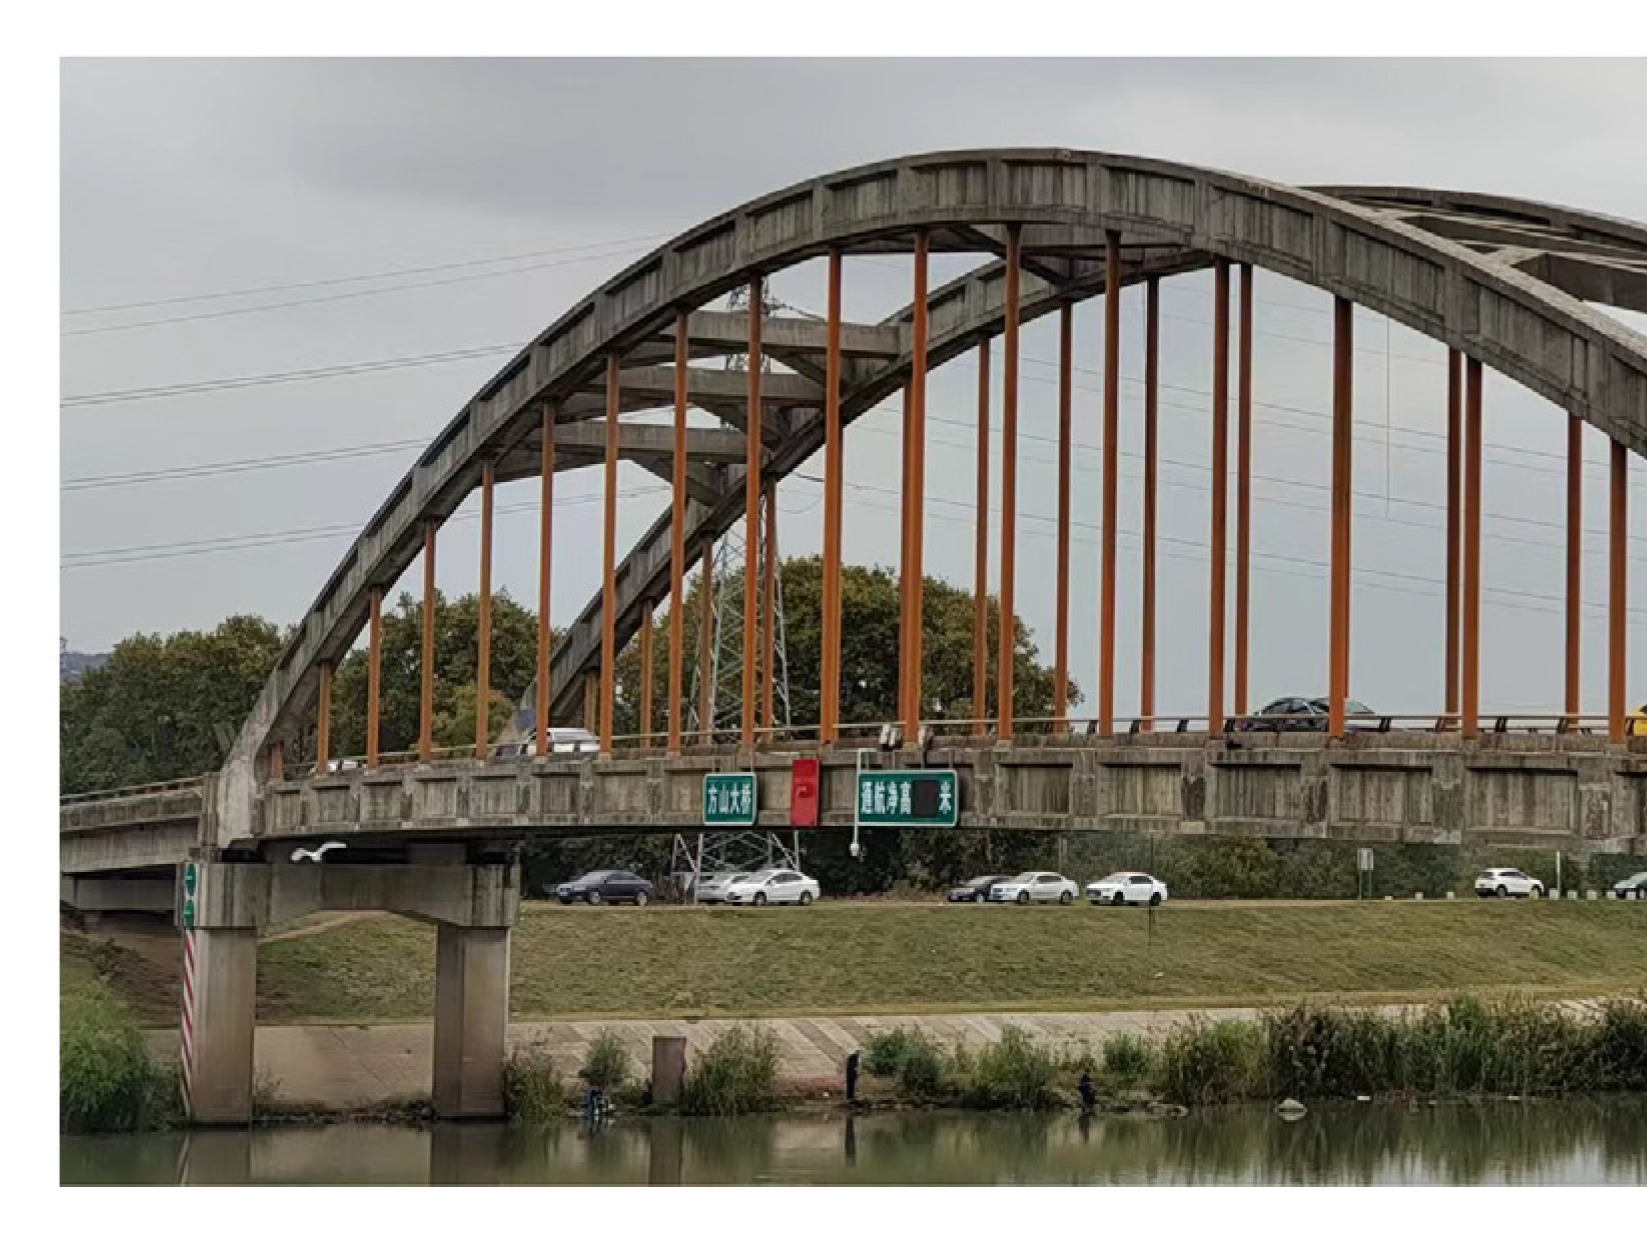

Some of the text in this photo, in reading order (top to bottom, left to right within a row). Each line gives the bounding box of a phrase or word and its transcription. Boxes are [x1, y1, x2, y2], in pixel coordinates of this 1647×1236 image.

[708, 782, 752, 815] 方山大桥
[861, 780, 952, 815] 通航净高 米
